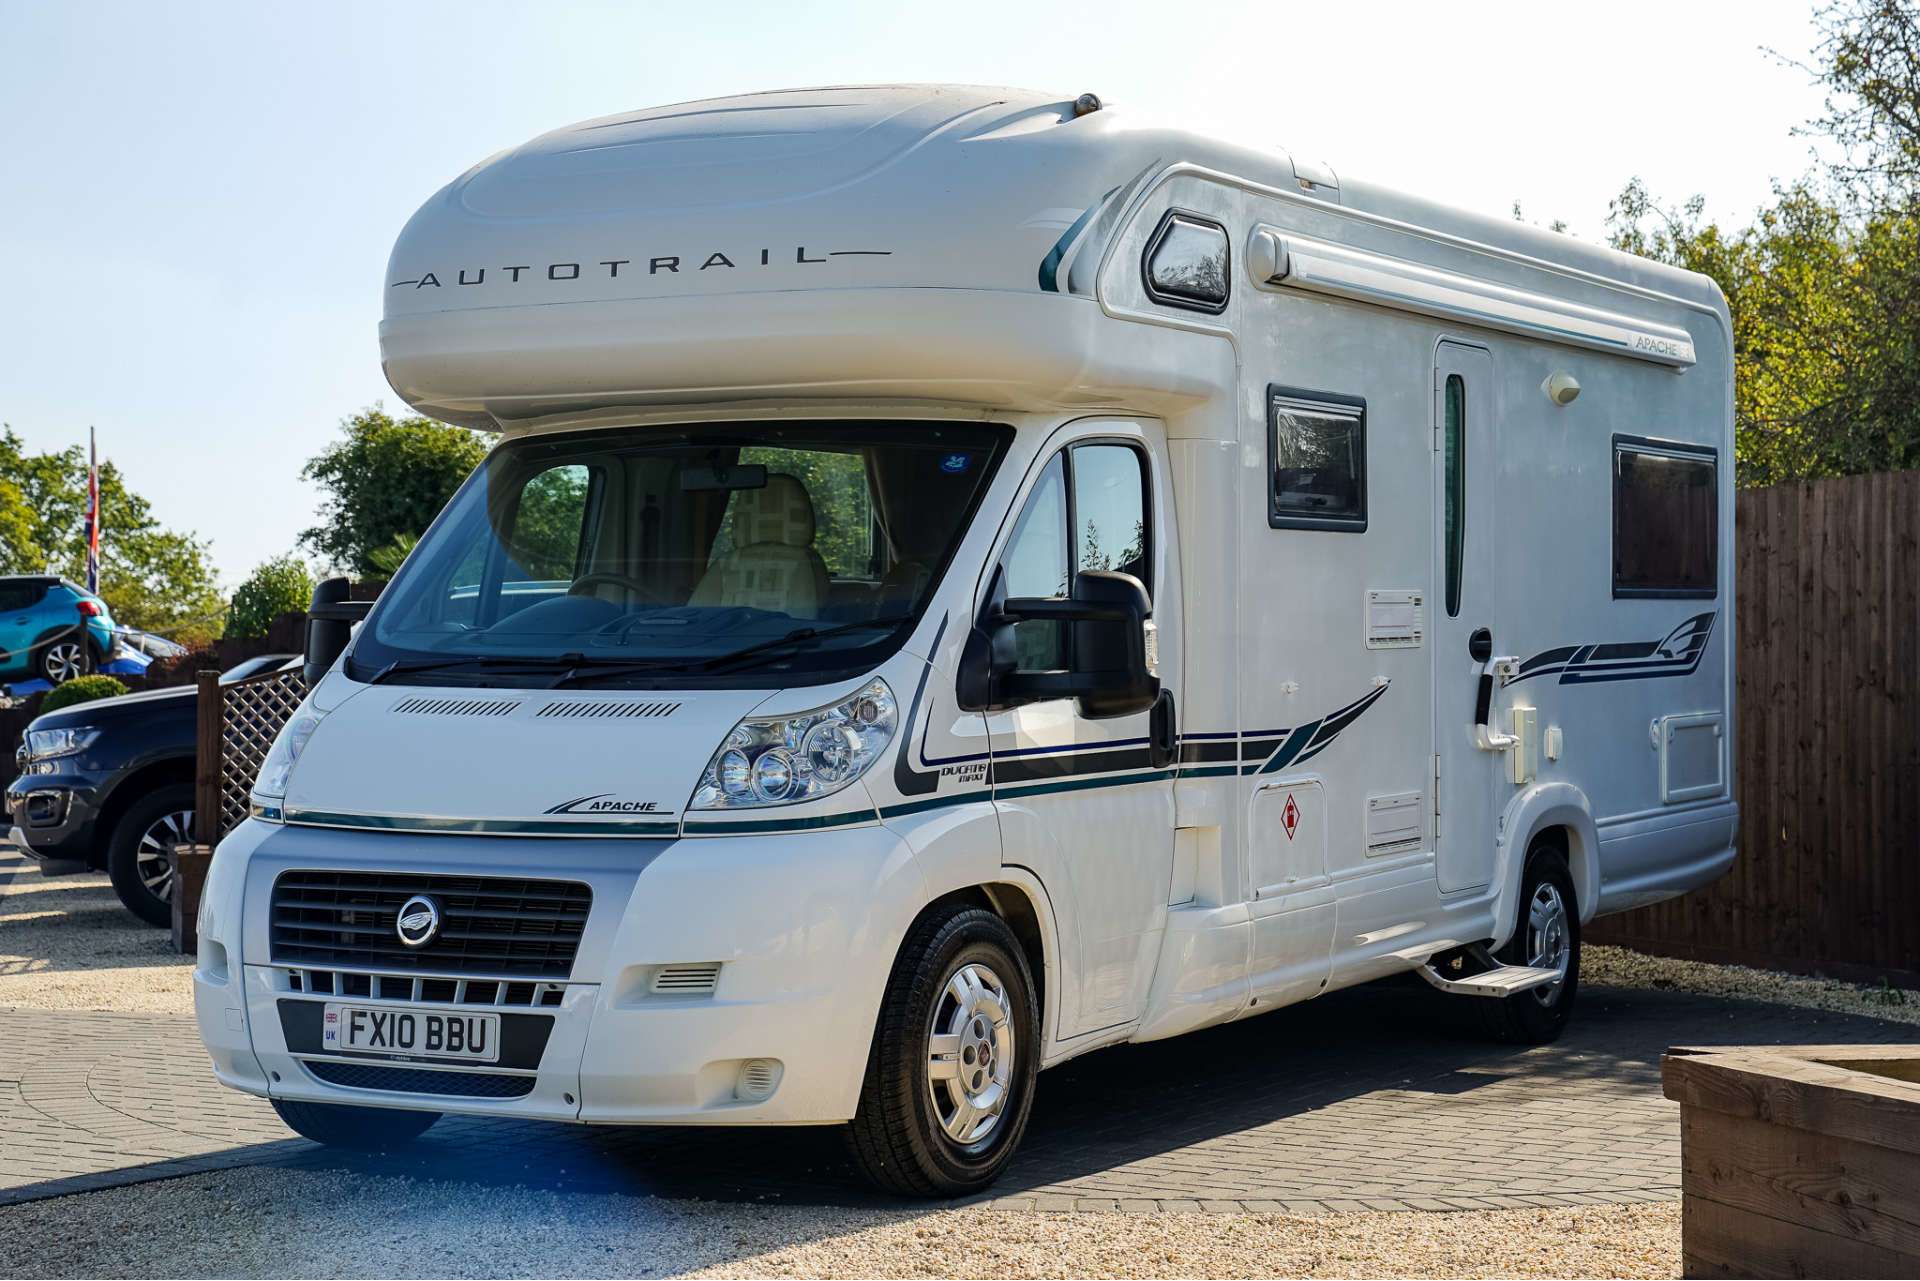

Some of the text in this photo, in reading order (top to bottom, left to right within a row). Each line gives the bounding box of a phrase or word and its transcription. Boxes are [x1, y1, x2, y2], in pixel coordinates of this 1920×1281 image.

[416, 246, 827, 289] AUTOTRAIL
[1636, 336, 1677, 356] APACHE
[588, 801, 658, 811] APACHE
[325, 1029, 336, 1041] UK
[349, 1010, 487, 1053] FX10 BBU
